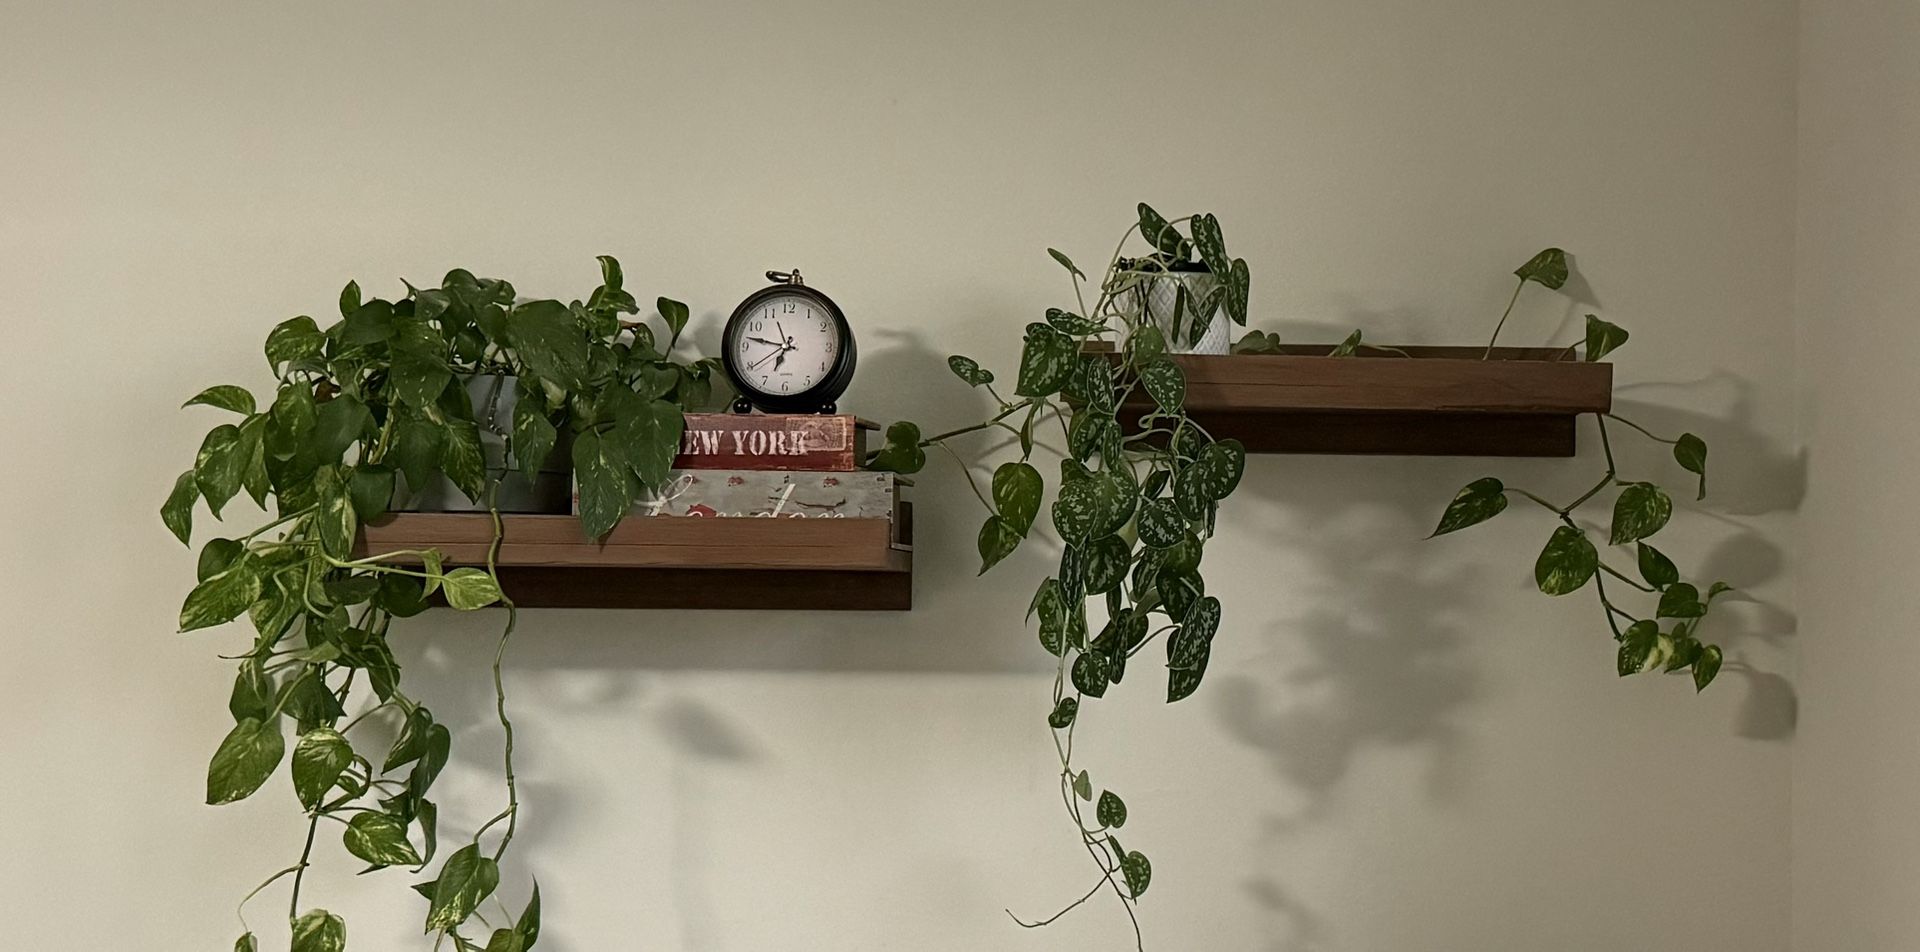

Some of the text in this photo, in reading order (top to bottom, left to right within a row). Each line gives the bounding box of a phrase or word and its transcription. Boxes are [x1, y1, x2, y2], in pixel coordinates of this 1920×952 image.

[764, 308, 776, 319] 11
[783, 303, 796, 314] 12
[806, 308, 811, 319] 1
[749, 321, 763, 332] 10
[820, 322, 827, 333] 2
[741, 342, 750, 353] 9
[825, 342, 833, 353] 3
[746, 361, 754, 371] 8
[819, 361, 825, 372] 4
[761, 375, 769, 386] 7
[803, 375, 811, 386] 5
[781, 381, 789, 392] 6
[677, 430, 809, 456] EW YORK
